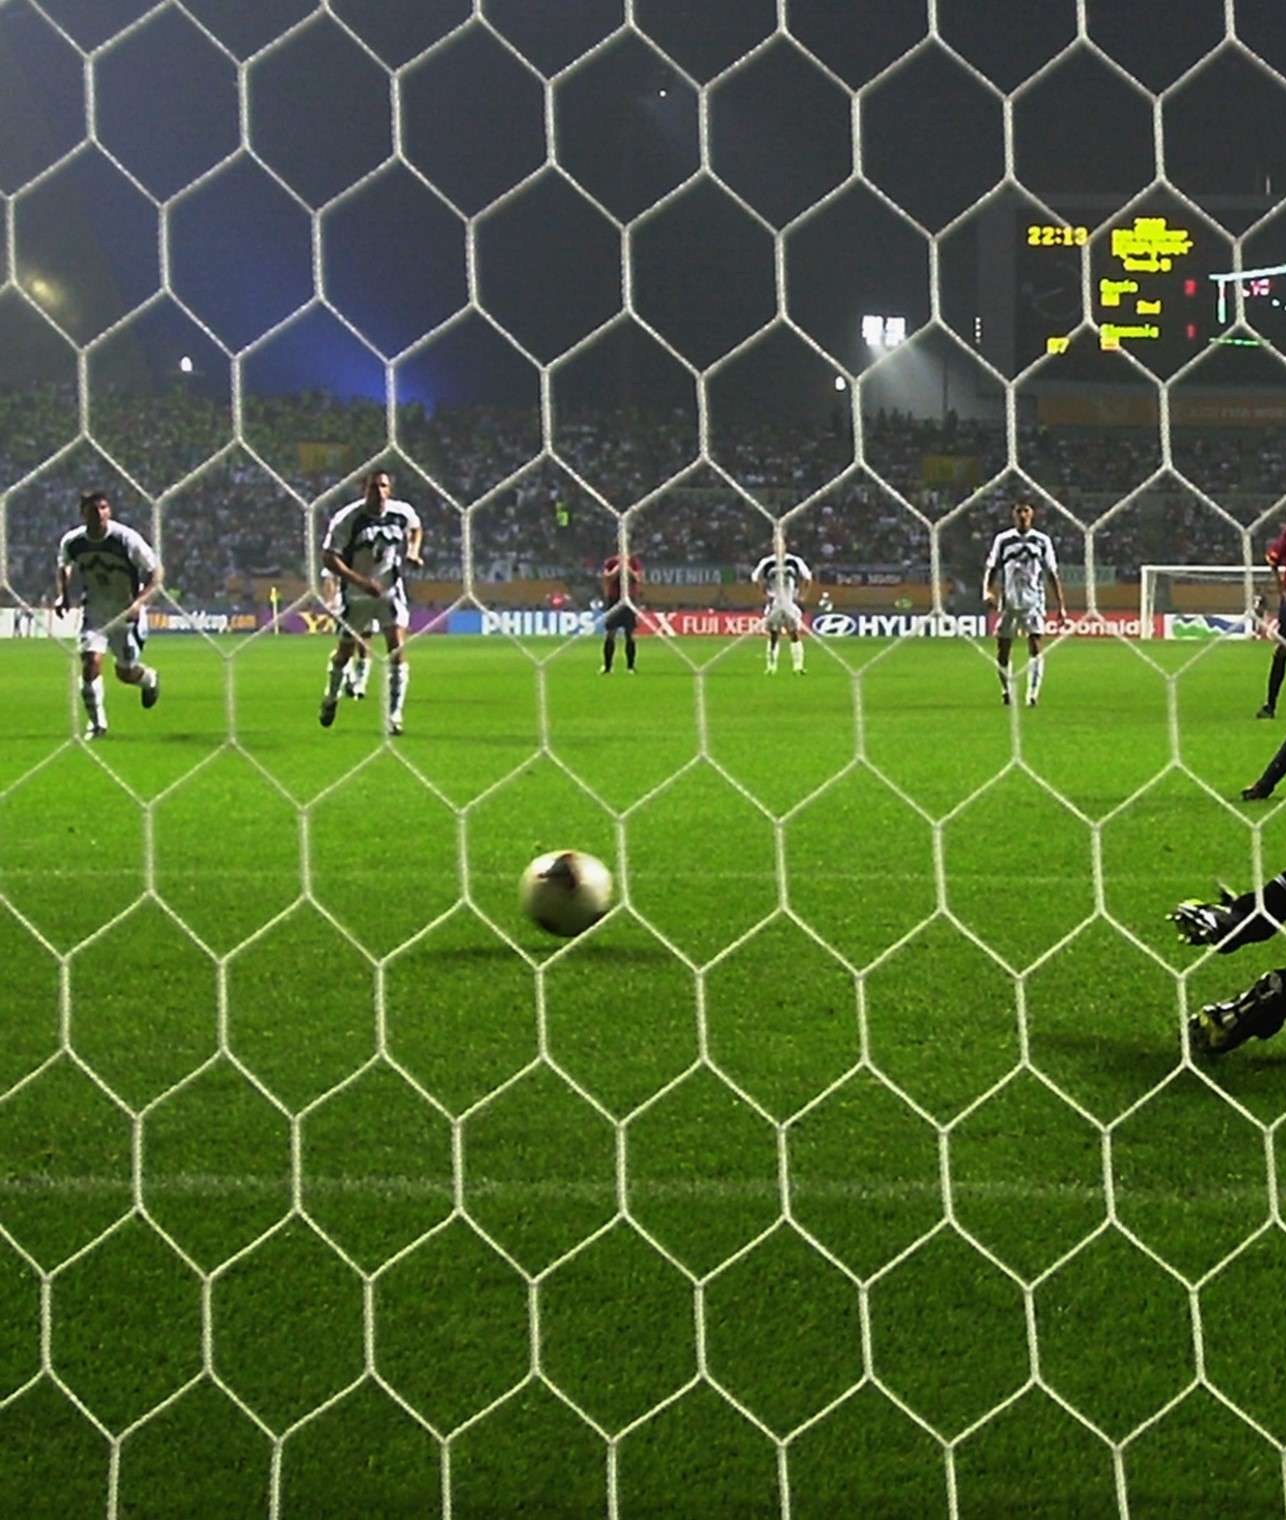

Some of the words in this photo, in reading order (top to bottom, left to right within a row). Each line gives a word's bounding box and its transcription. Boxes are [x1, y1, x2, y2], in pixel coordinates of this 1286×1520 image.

[1027, 226, 1088, 246] 22:13
[642, 568, 721, 585] LOVENIJA
[481, 611, 599, 636] PHILIPS
[683, 615, 719, 635] FUJI
[725, 615, 767, 635] XER
[859, 615, 986, 637] HYUNDAI
